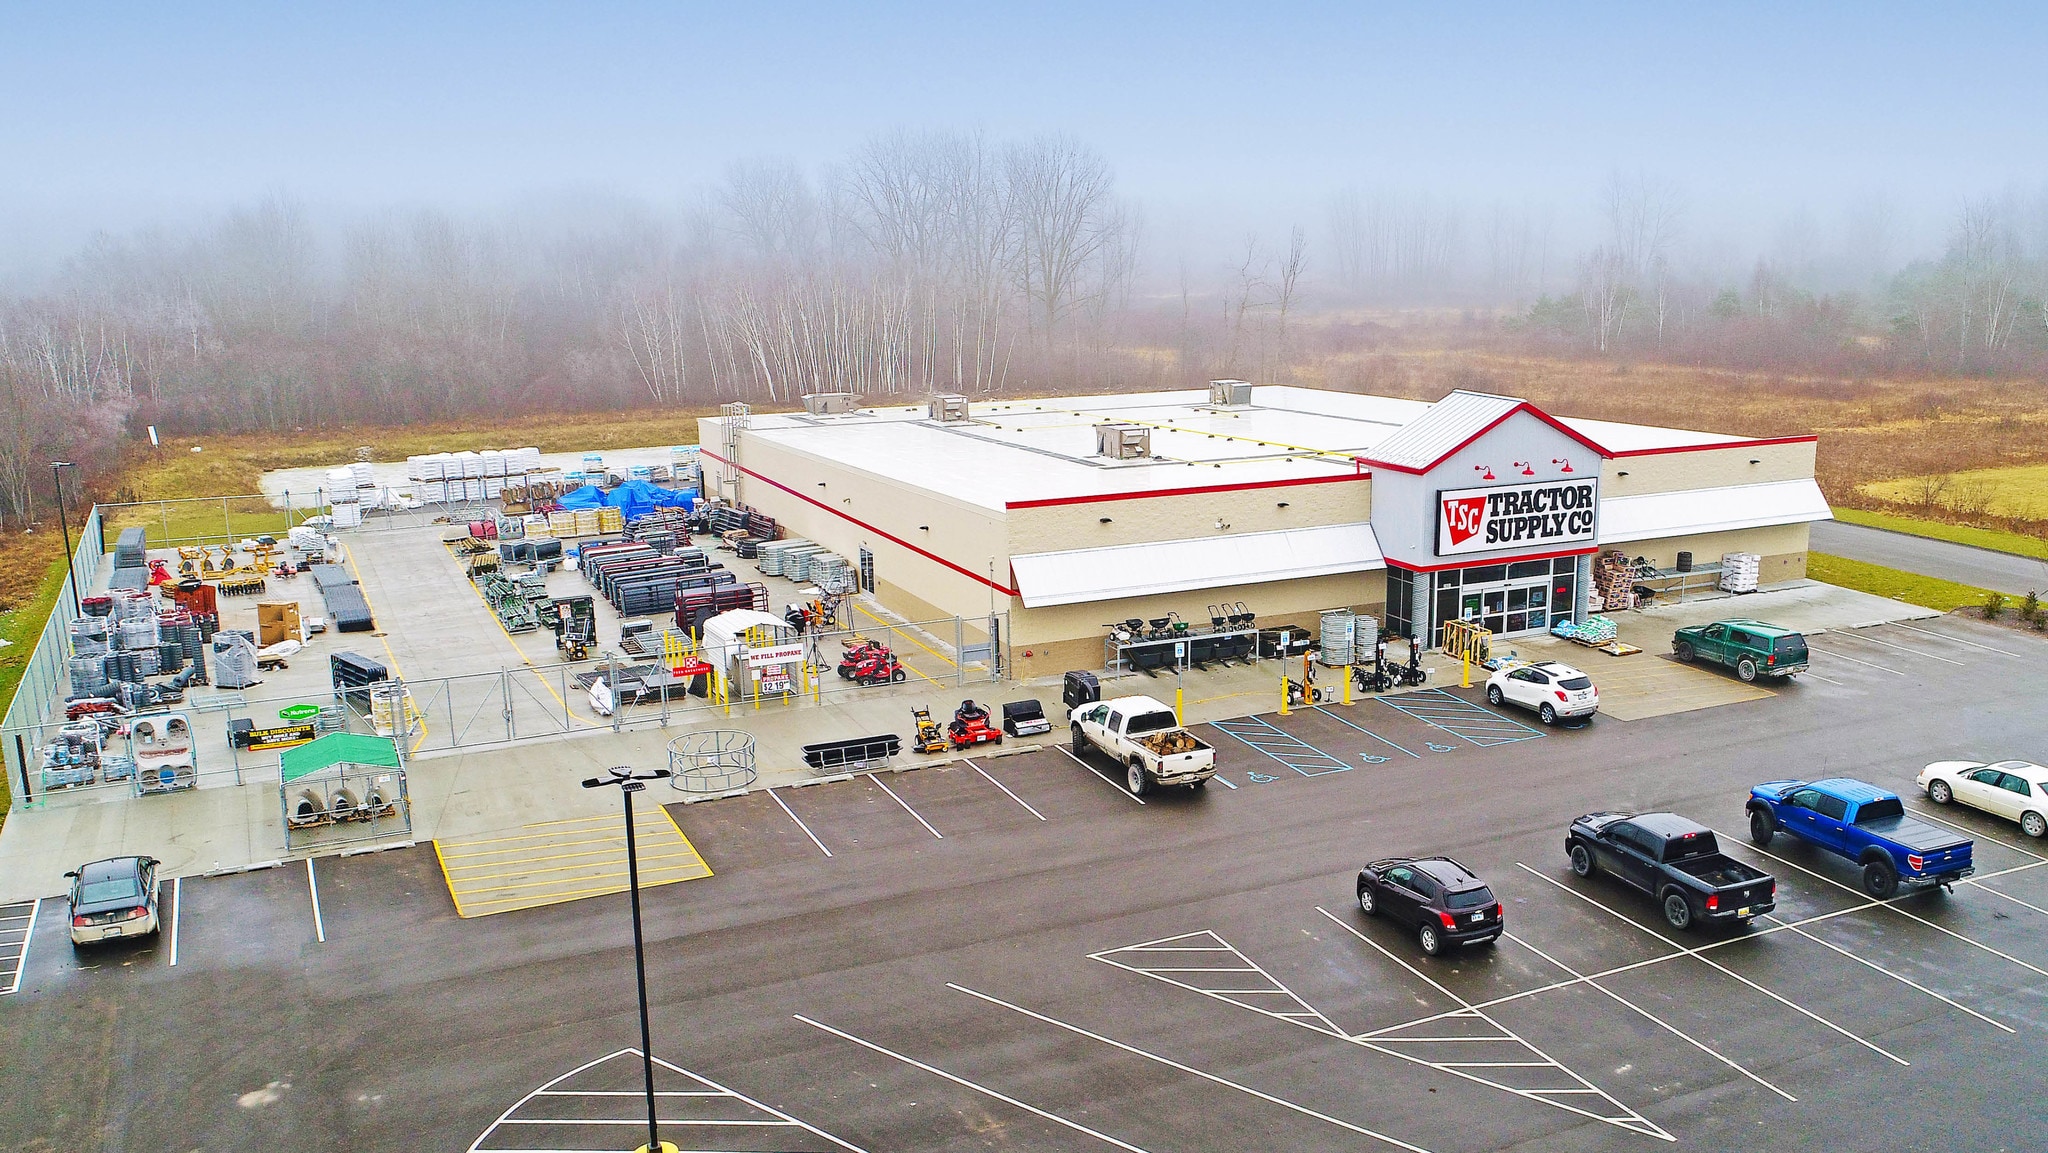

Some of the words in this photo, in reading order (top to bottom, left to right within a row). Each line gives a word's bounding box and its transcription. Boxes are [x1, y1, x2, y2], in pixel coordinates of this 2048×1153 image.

[1487, 485, 1593, 517] TRACTOR
[1448, 501, 1479, 534] TSC
[1486, 512, 1567, 544] SUPPLY
[775, 649, 802, 658] PROPANE
[270, 725, 311, 734] DISCOUNTS
